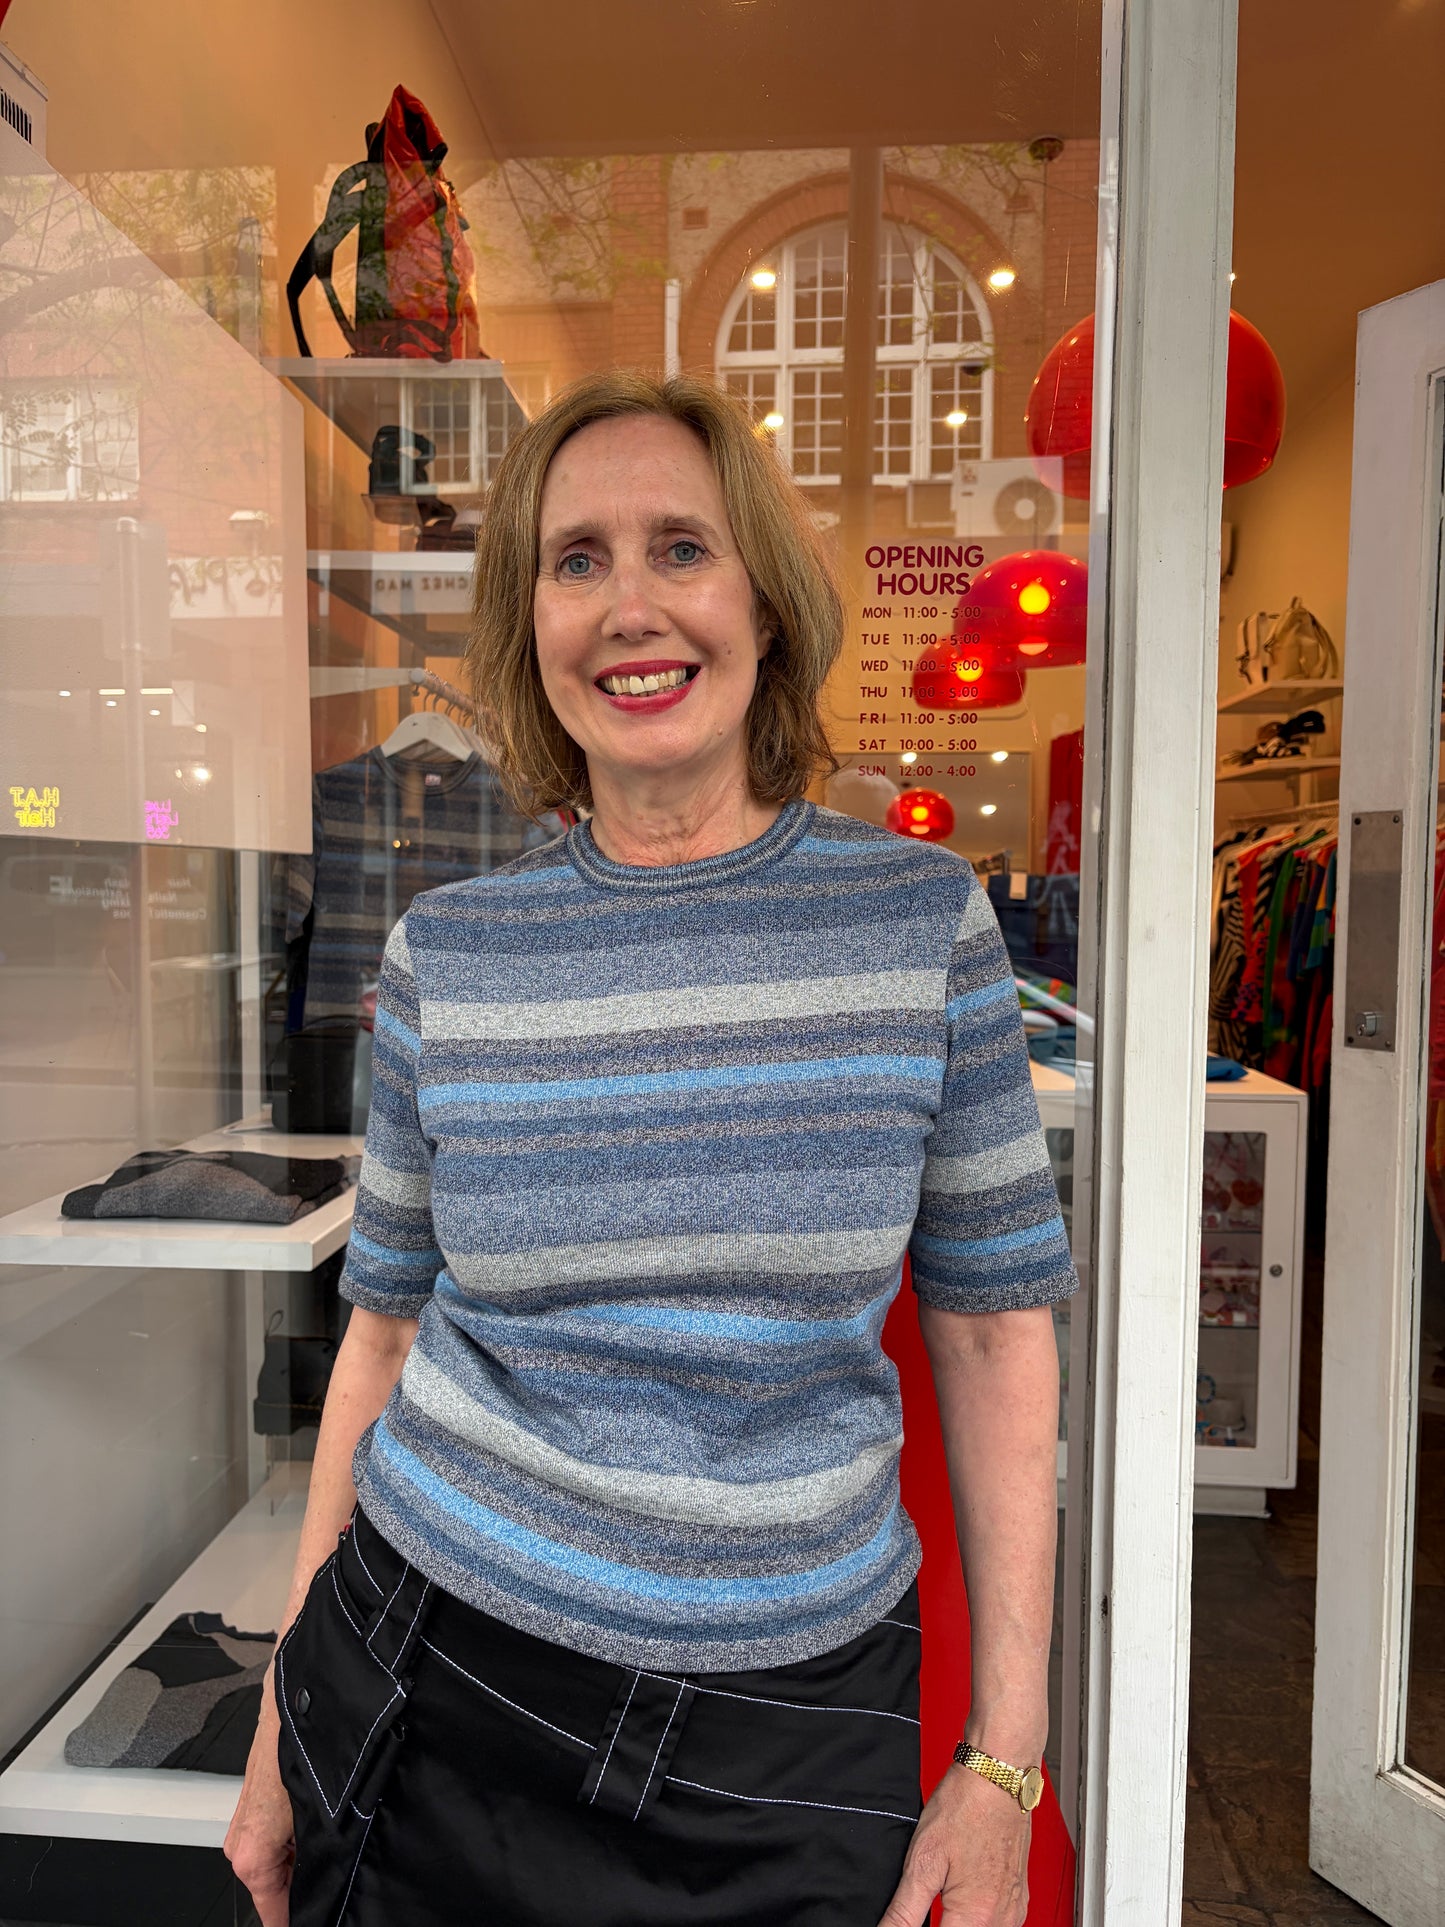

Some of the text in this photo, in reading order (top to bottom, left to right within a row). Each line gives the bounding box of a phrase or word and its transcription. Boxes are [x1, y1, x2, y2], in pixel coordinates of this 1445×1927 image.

[865, 545, 984, 568] OPENING
[877, 572, 971, 595] HOURS
[862, 607, 892, 618] MON
[903, 607, 938, 618] 11:00
[950, 606, 981, 618] 5:00
[861, 633, 890, 645] TUE
[902, 633, 937, 645] 11:00
[950, 633, 981, 646] 5:00
[861, 660, 889, 671] WED
[860, 686, 888, 698] THU
[859, 713, 886, 724] FRI
[900, 713, 935, 724] 11:00
[947, 712, 978, 725] 5:00
[858, 739, 887, 750] SAT
[899, 739, 934, 750] 10:00
[947, 739, 977, 750] 5:00
[858, 765, 886, 776] SUN
[899, 765, 933, 776] 12:00
[946, 765, 976, 776] 4:00
